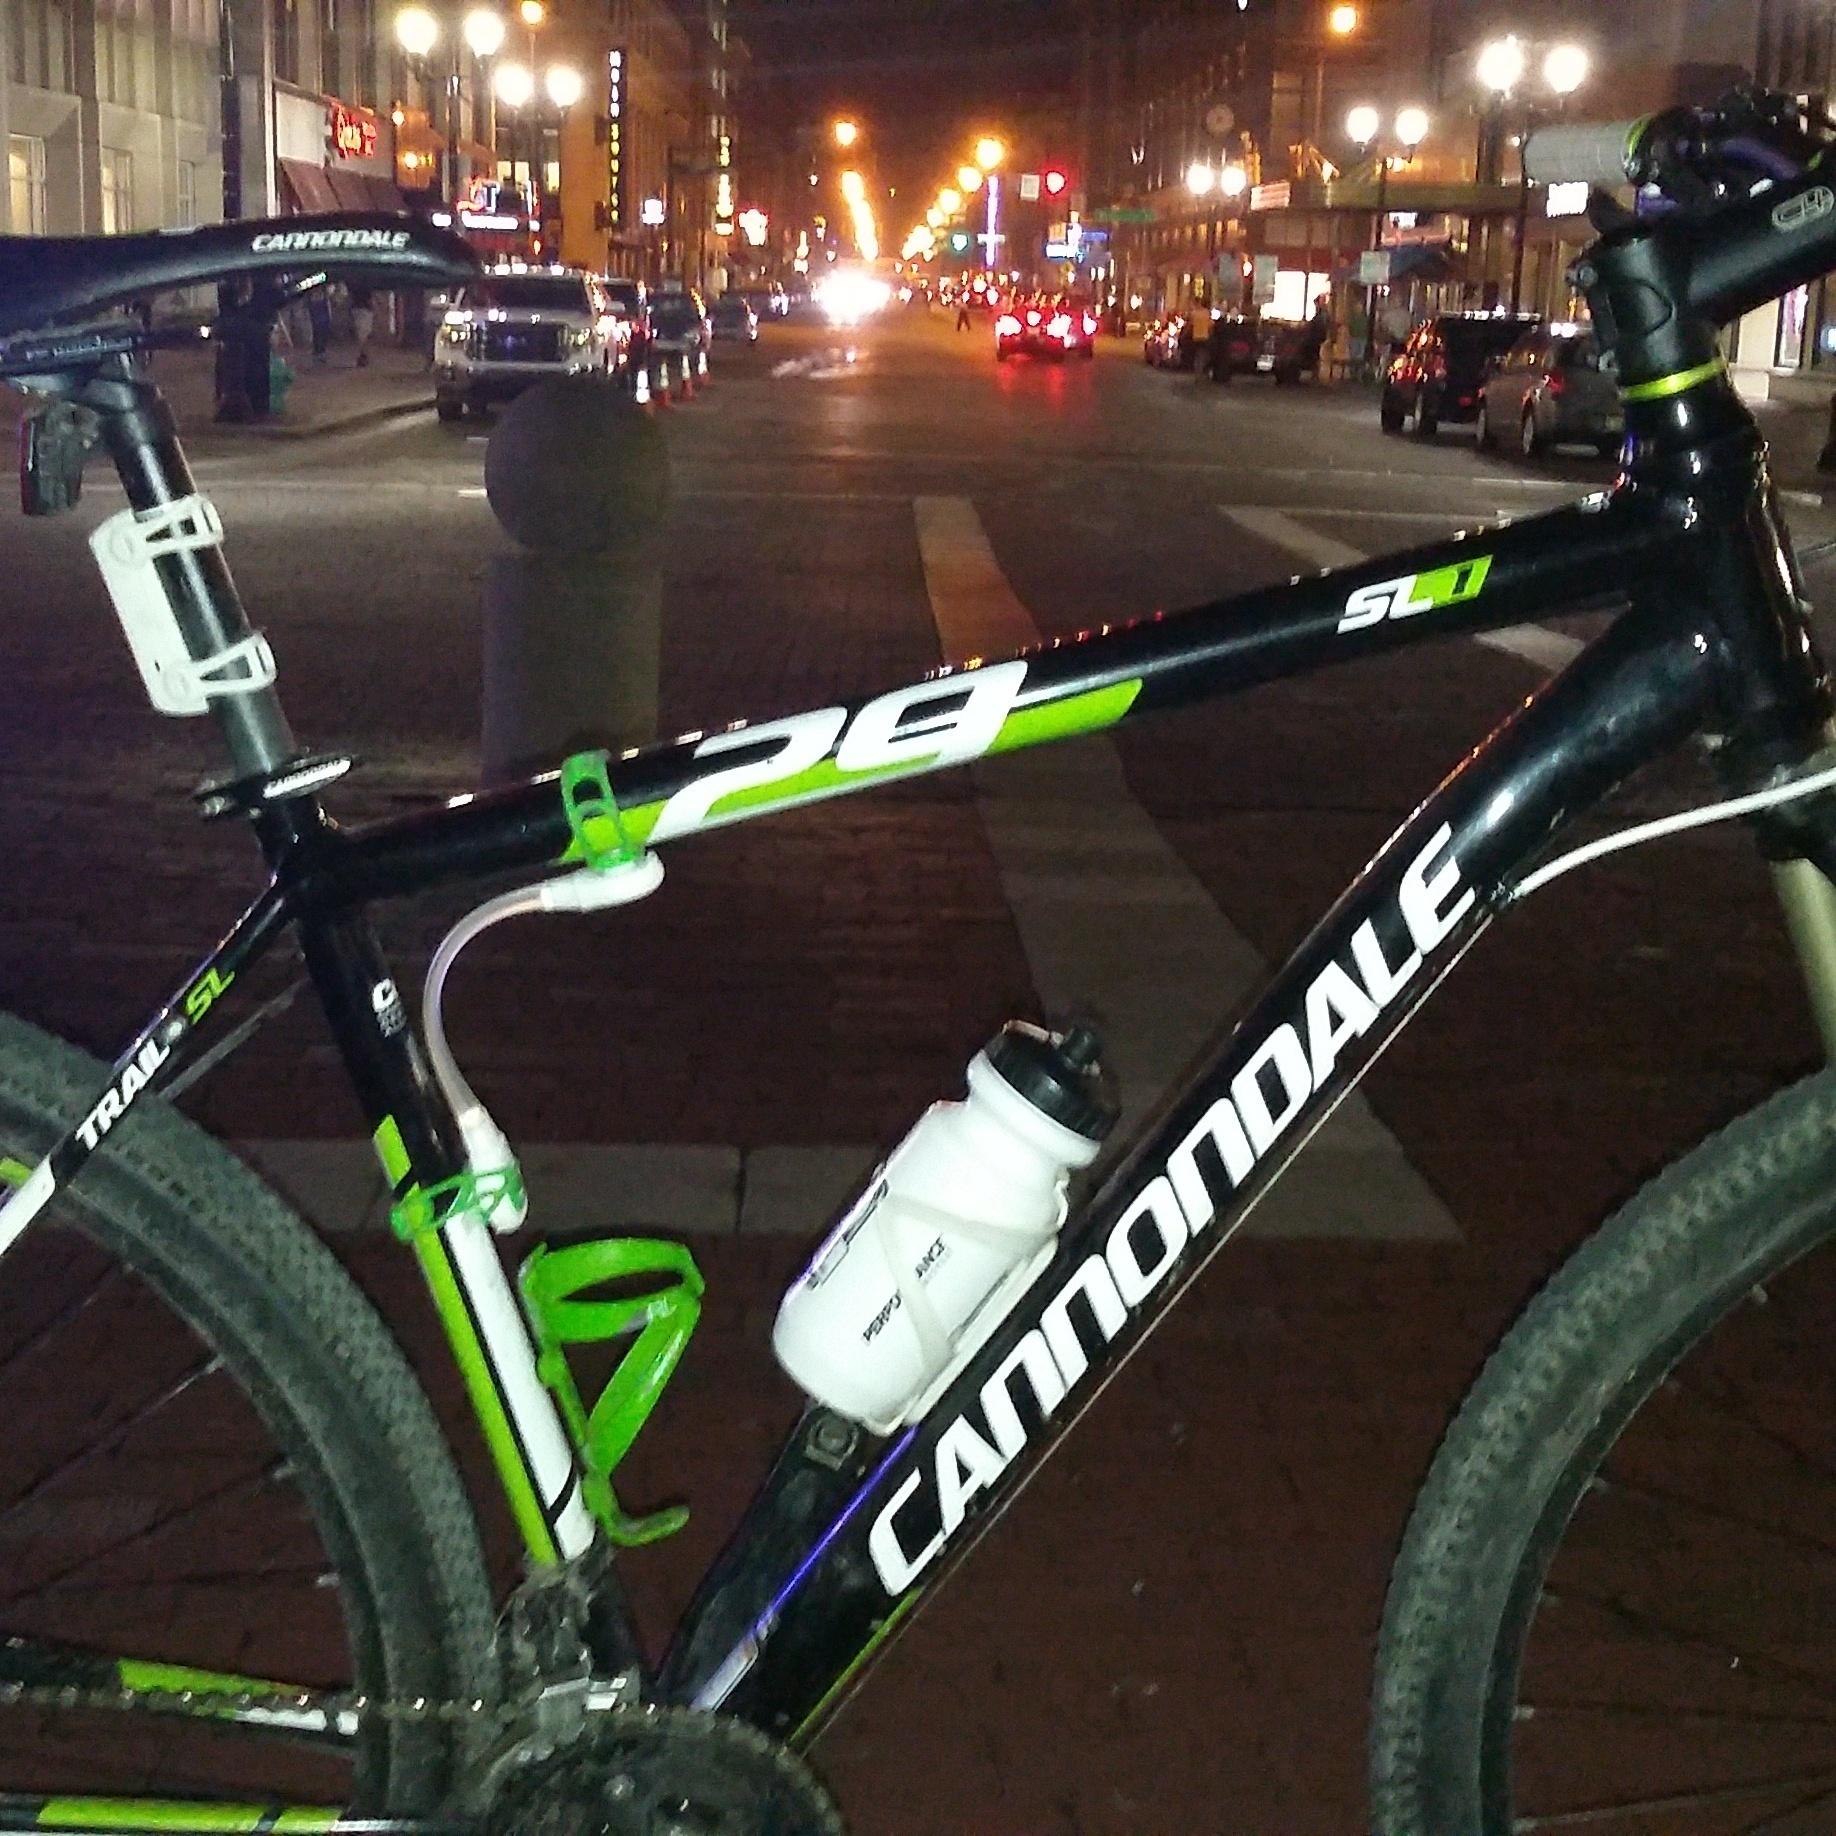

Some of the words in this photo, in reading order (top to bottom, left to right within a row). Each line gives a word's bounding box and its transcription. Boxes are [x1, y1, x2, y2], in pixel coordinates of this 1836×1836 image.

[252, 229, 411, 251] CANNONDALE
[75, 1037, 171, 1150] TRAIL
[185, 967, 236, 1025] SL
[867, 822, 1478, 1597] CANNONDALE
